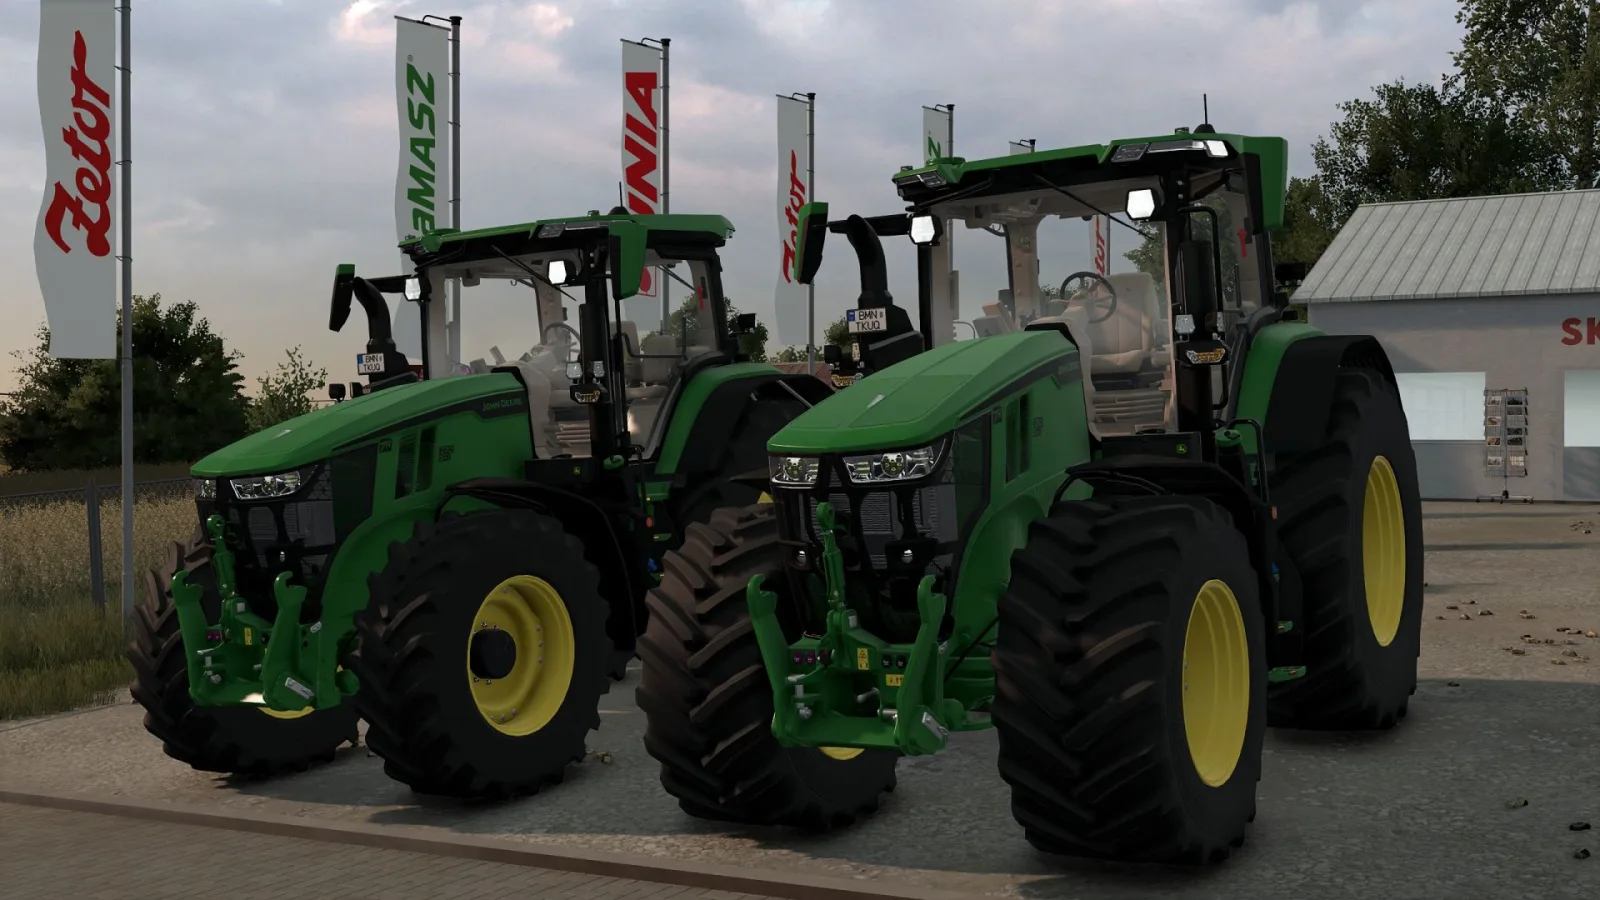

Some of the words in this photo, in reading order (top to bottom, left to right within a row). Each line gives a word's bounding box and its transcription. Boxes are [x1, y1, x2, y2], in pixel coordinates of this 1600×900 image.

[44, 30, 111, 257] Zetor
[858, 310, 878, 321] BMN
[1560, 316, 1600, 346] SK
